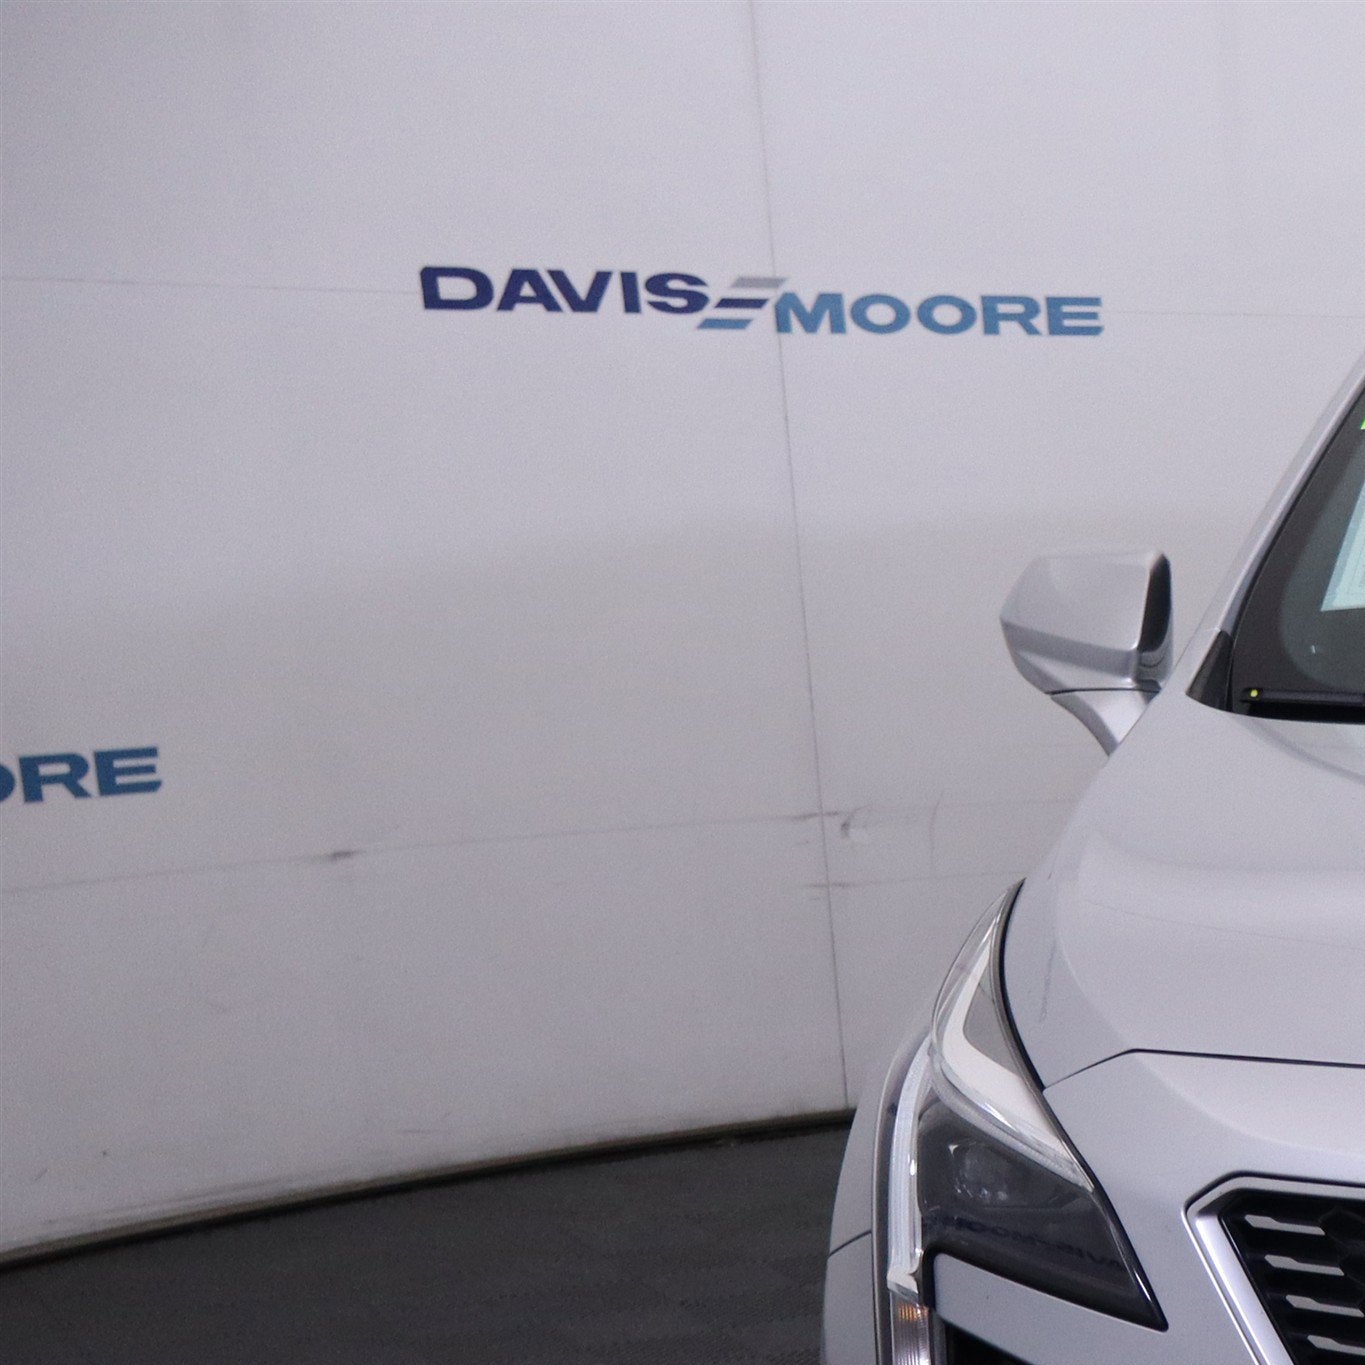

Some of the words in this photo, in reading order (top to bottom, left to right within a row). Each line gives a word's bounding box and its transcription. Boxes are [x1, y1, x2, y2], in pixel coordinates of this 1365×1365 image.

[419, 265, 711, 315] DAVIS
[774, 291, 1105, 336] MOORE
[0, 745, 163, 805] RE
